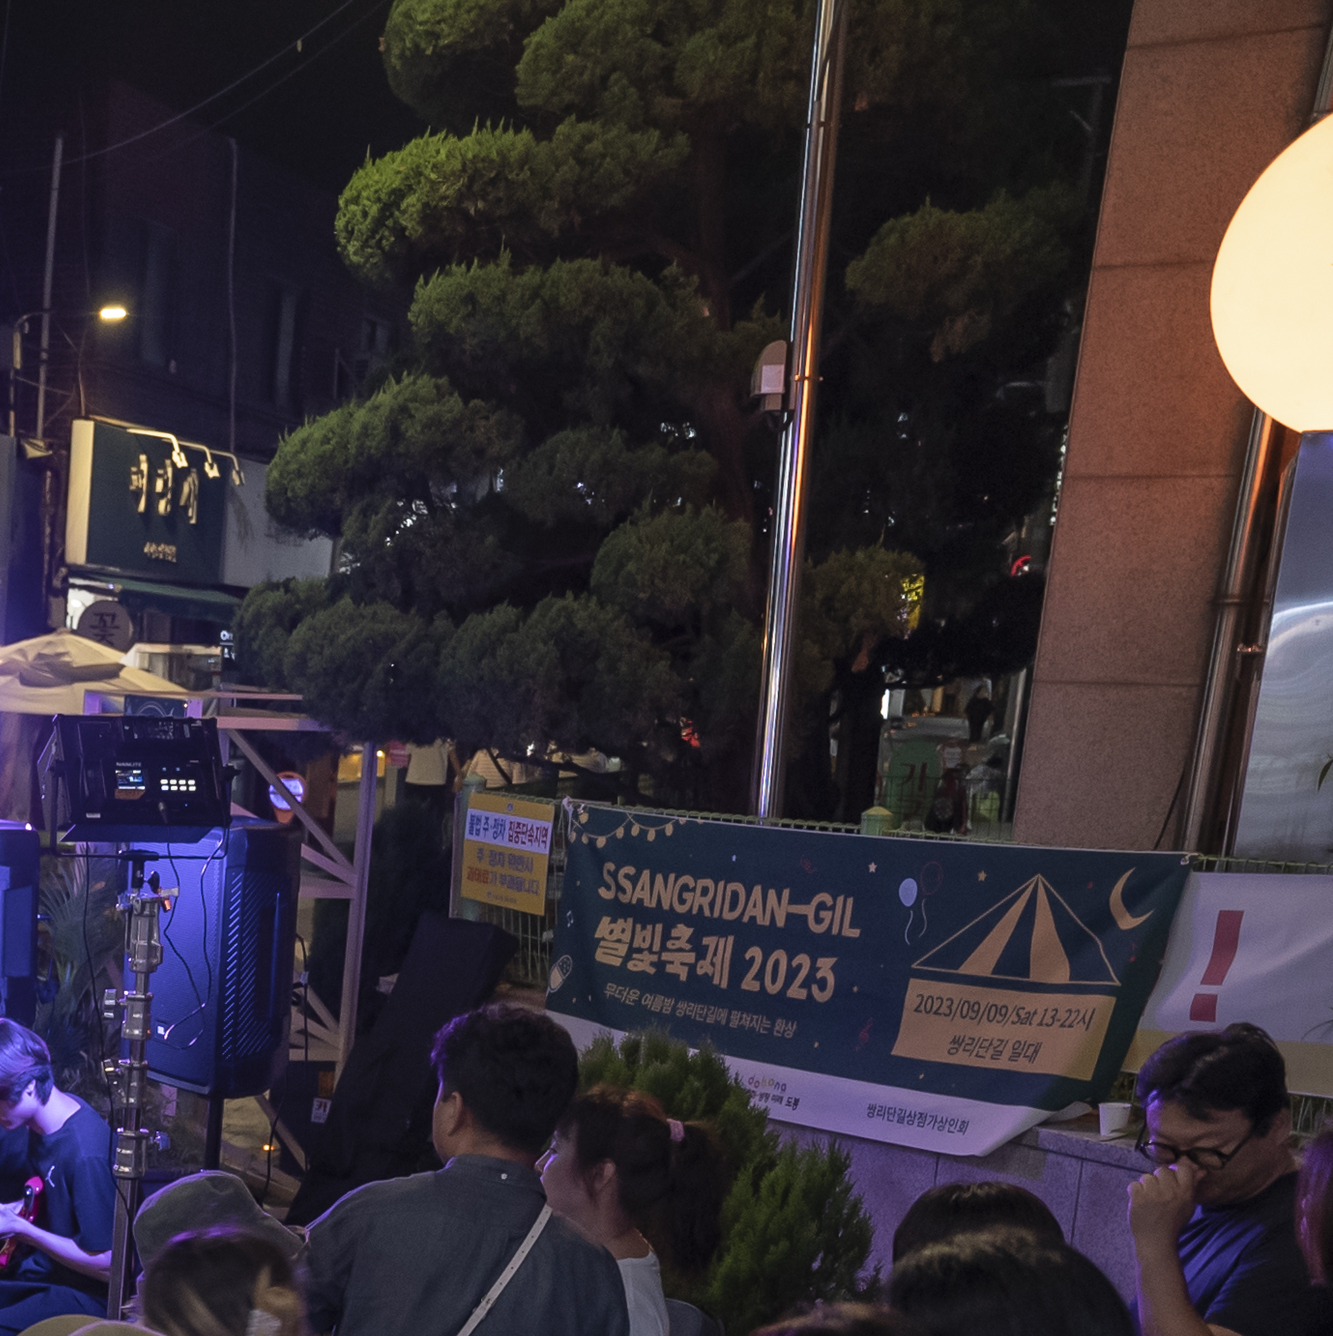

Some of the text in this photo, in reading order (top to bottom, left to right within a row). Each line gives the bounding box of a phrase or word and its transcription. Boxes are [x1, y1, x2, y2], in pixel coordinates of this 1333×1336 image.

[598, 861, 862, 938] SSANGRIDAN-GIL
[594, 915, 838, 1003] 별빛축제 2023
[603, 982, 799, 1039] 무더운 여름밤 쌍리단길에 펼쳐지는 환상
[913, 993, 1096, 1032] 2023/09/09/Sat 13-22시
[946, 1034, 1043, 1064] 쌍리단길 일대
[866, 1102, 970, 1136] 쌍리단길상점가상인회
